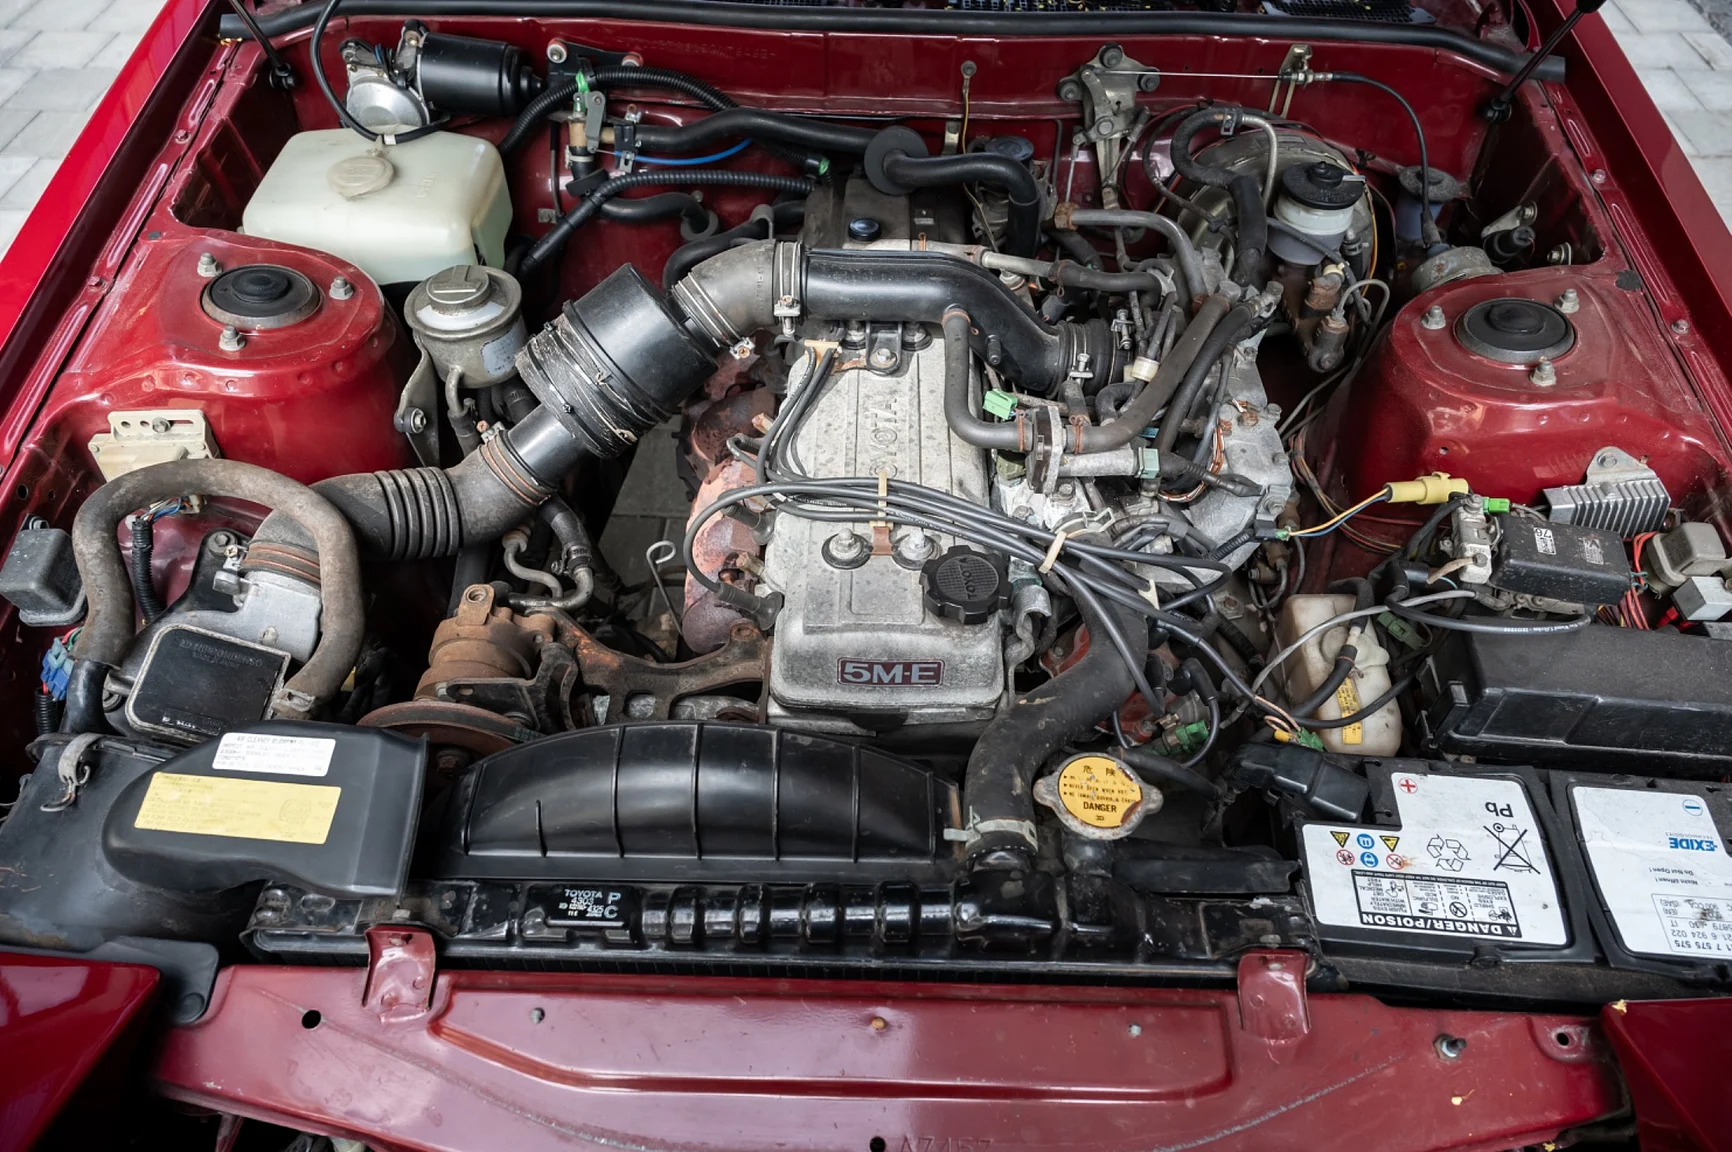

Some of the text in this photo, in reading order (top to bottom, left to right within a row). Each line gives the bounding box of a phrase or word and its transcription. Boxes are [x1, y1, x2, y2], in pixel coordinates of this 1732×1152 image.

[868, 398, 898, 478] OYOTA
[843, 662, 938, 684] 5M-E
[1083, 802, 1117, 812] DANGER
[1485, 802, 1514, 818] Pb
[1669, 837, 1718, 852] EXIDE
[564, 889, 603, 899] TOYOTA
[607, 892, 622, 904] P
[604, 906, 618, 918] C
[1362, 913, 1503, 935] DANGER/POISON
[1671, 930, 1687, 938] 022
[1690, 932, 1708, 940] 924
[1674, 940, 1692, 948] 575
[1694, 942, 1712, 950] 575
